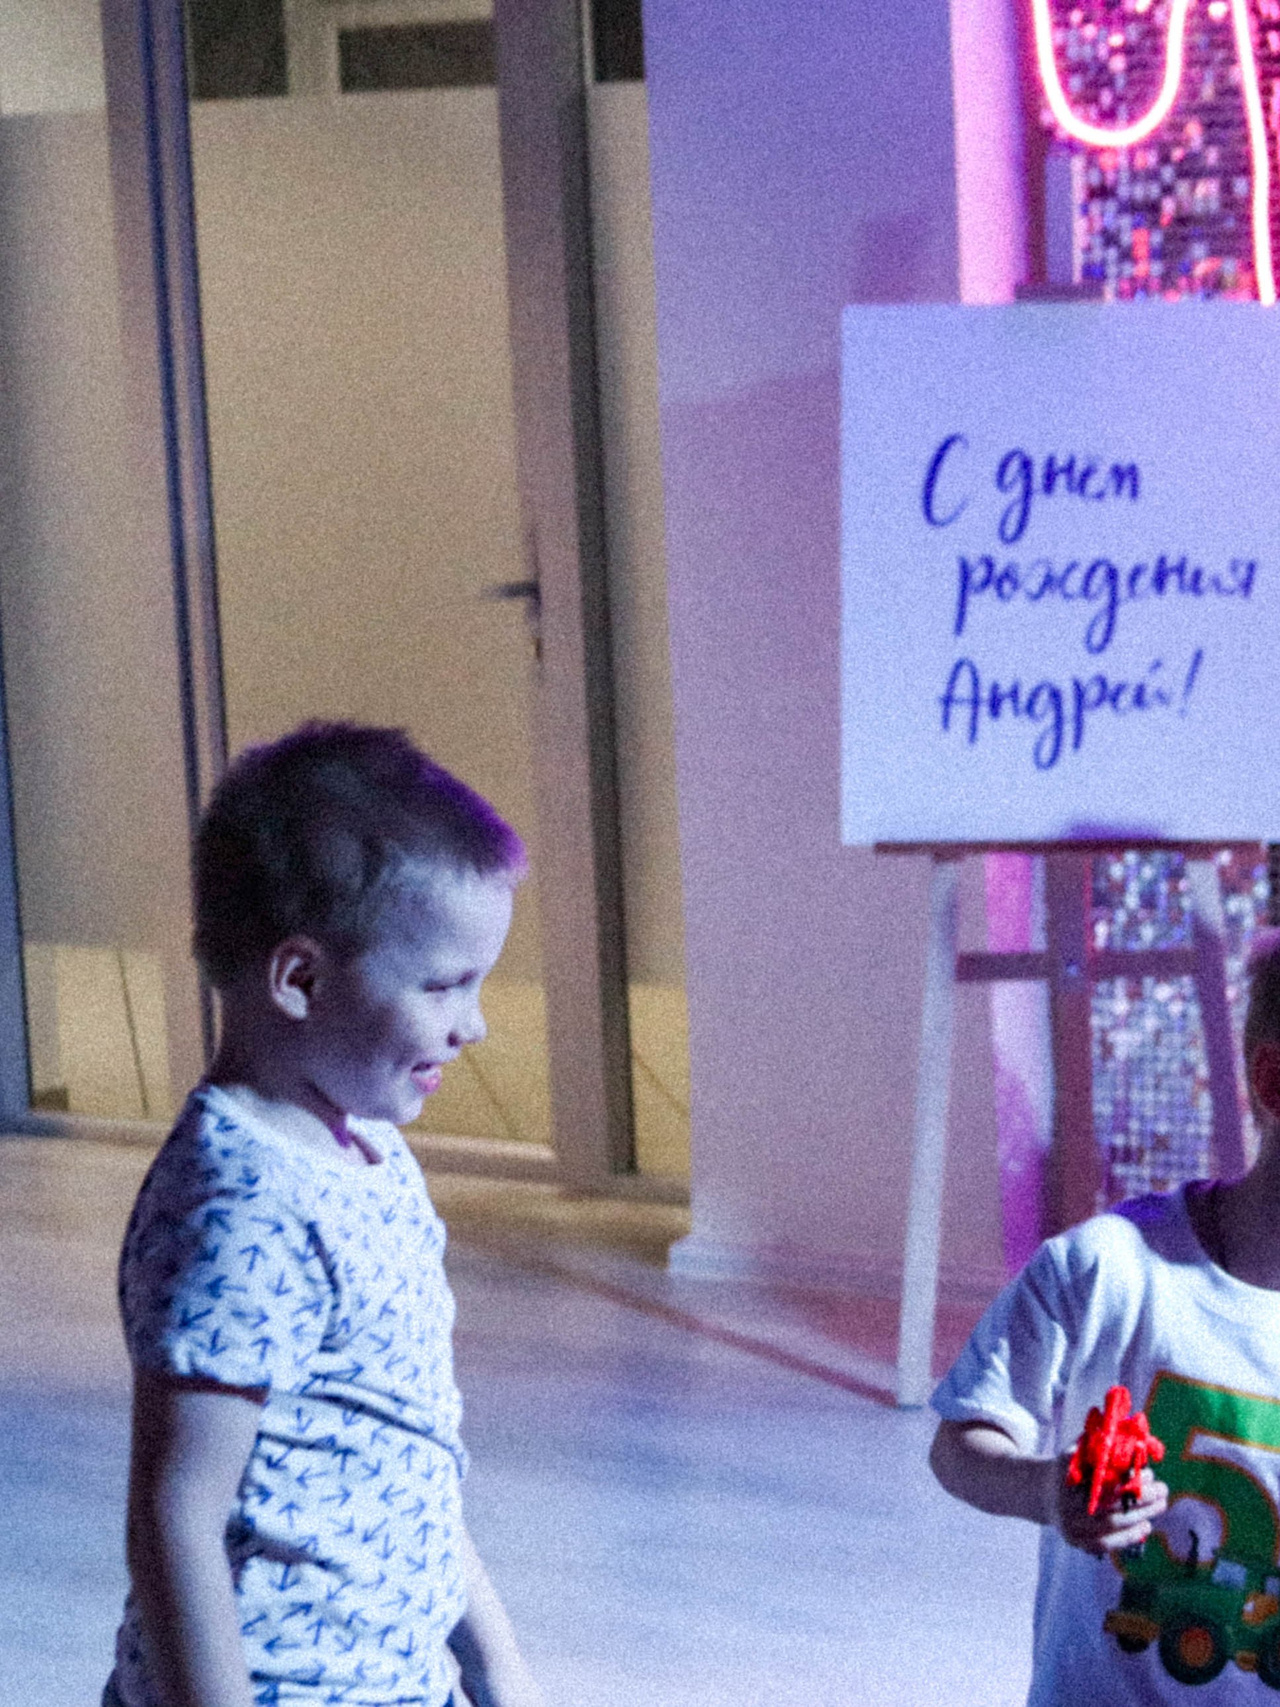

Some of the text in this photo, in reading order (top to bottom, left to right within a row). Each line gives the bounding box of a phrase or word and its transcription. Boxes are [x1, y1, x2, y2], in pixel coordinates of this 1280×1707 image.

[920, 432, 1142, 545] С днем
[952, 553, 1260, 655] рождения
[936, 647, 1204, 772] Андрей!
